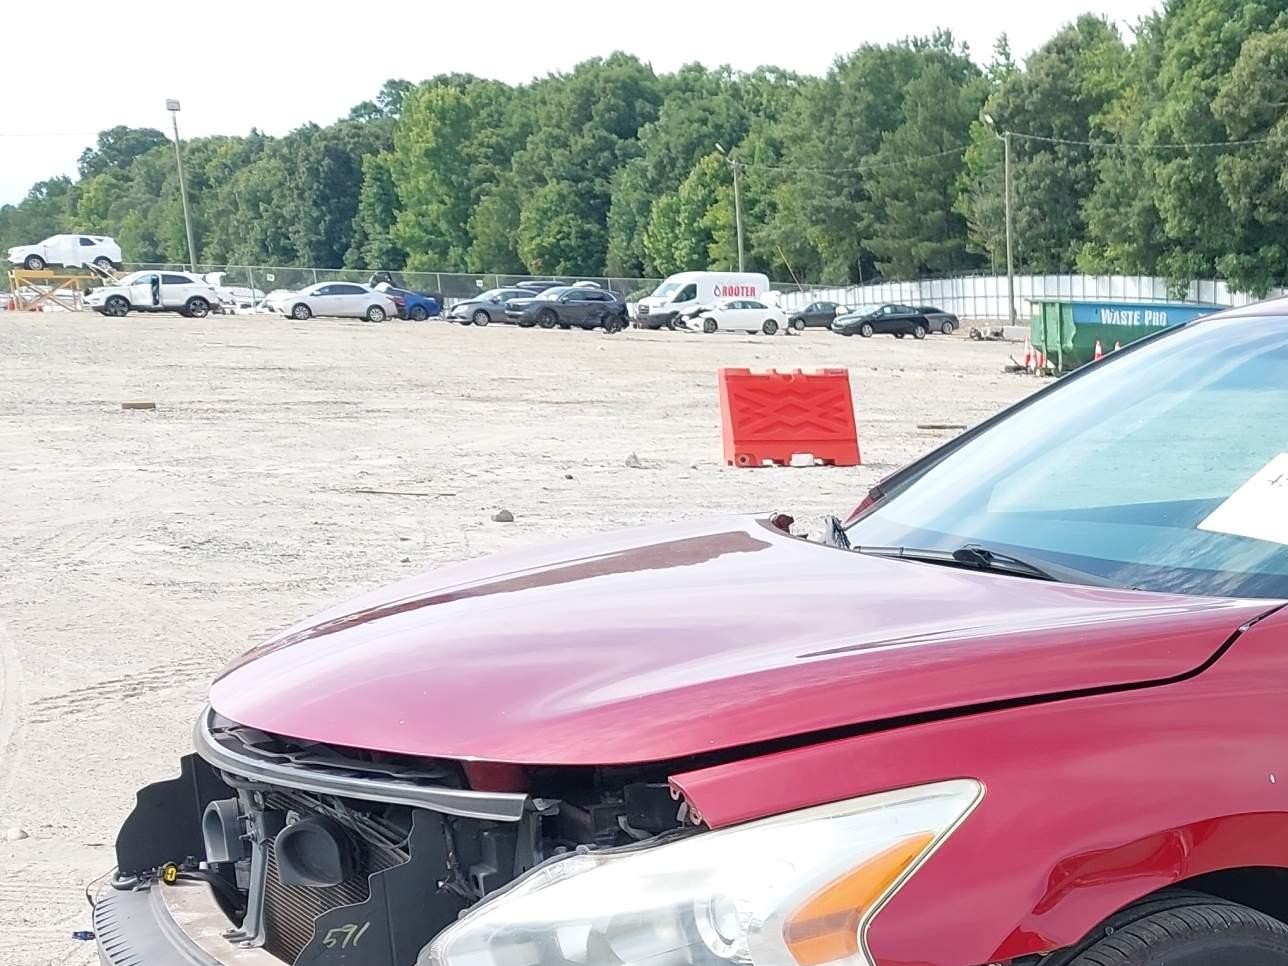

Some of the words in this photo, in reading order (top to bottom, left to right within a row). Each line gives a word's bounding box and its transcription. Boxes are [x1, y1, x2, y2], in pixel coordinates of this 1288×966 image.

[721, 284, 757, 298] ROOTER
[1100, 307, 1141, 327] WASTE
[1144, 308, 1168, 328] PRO
